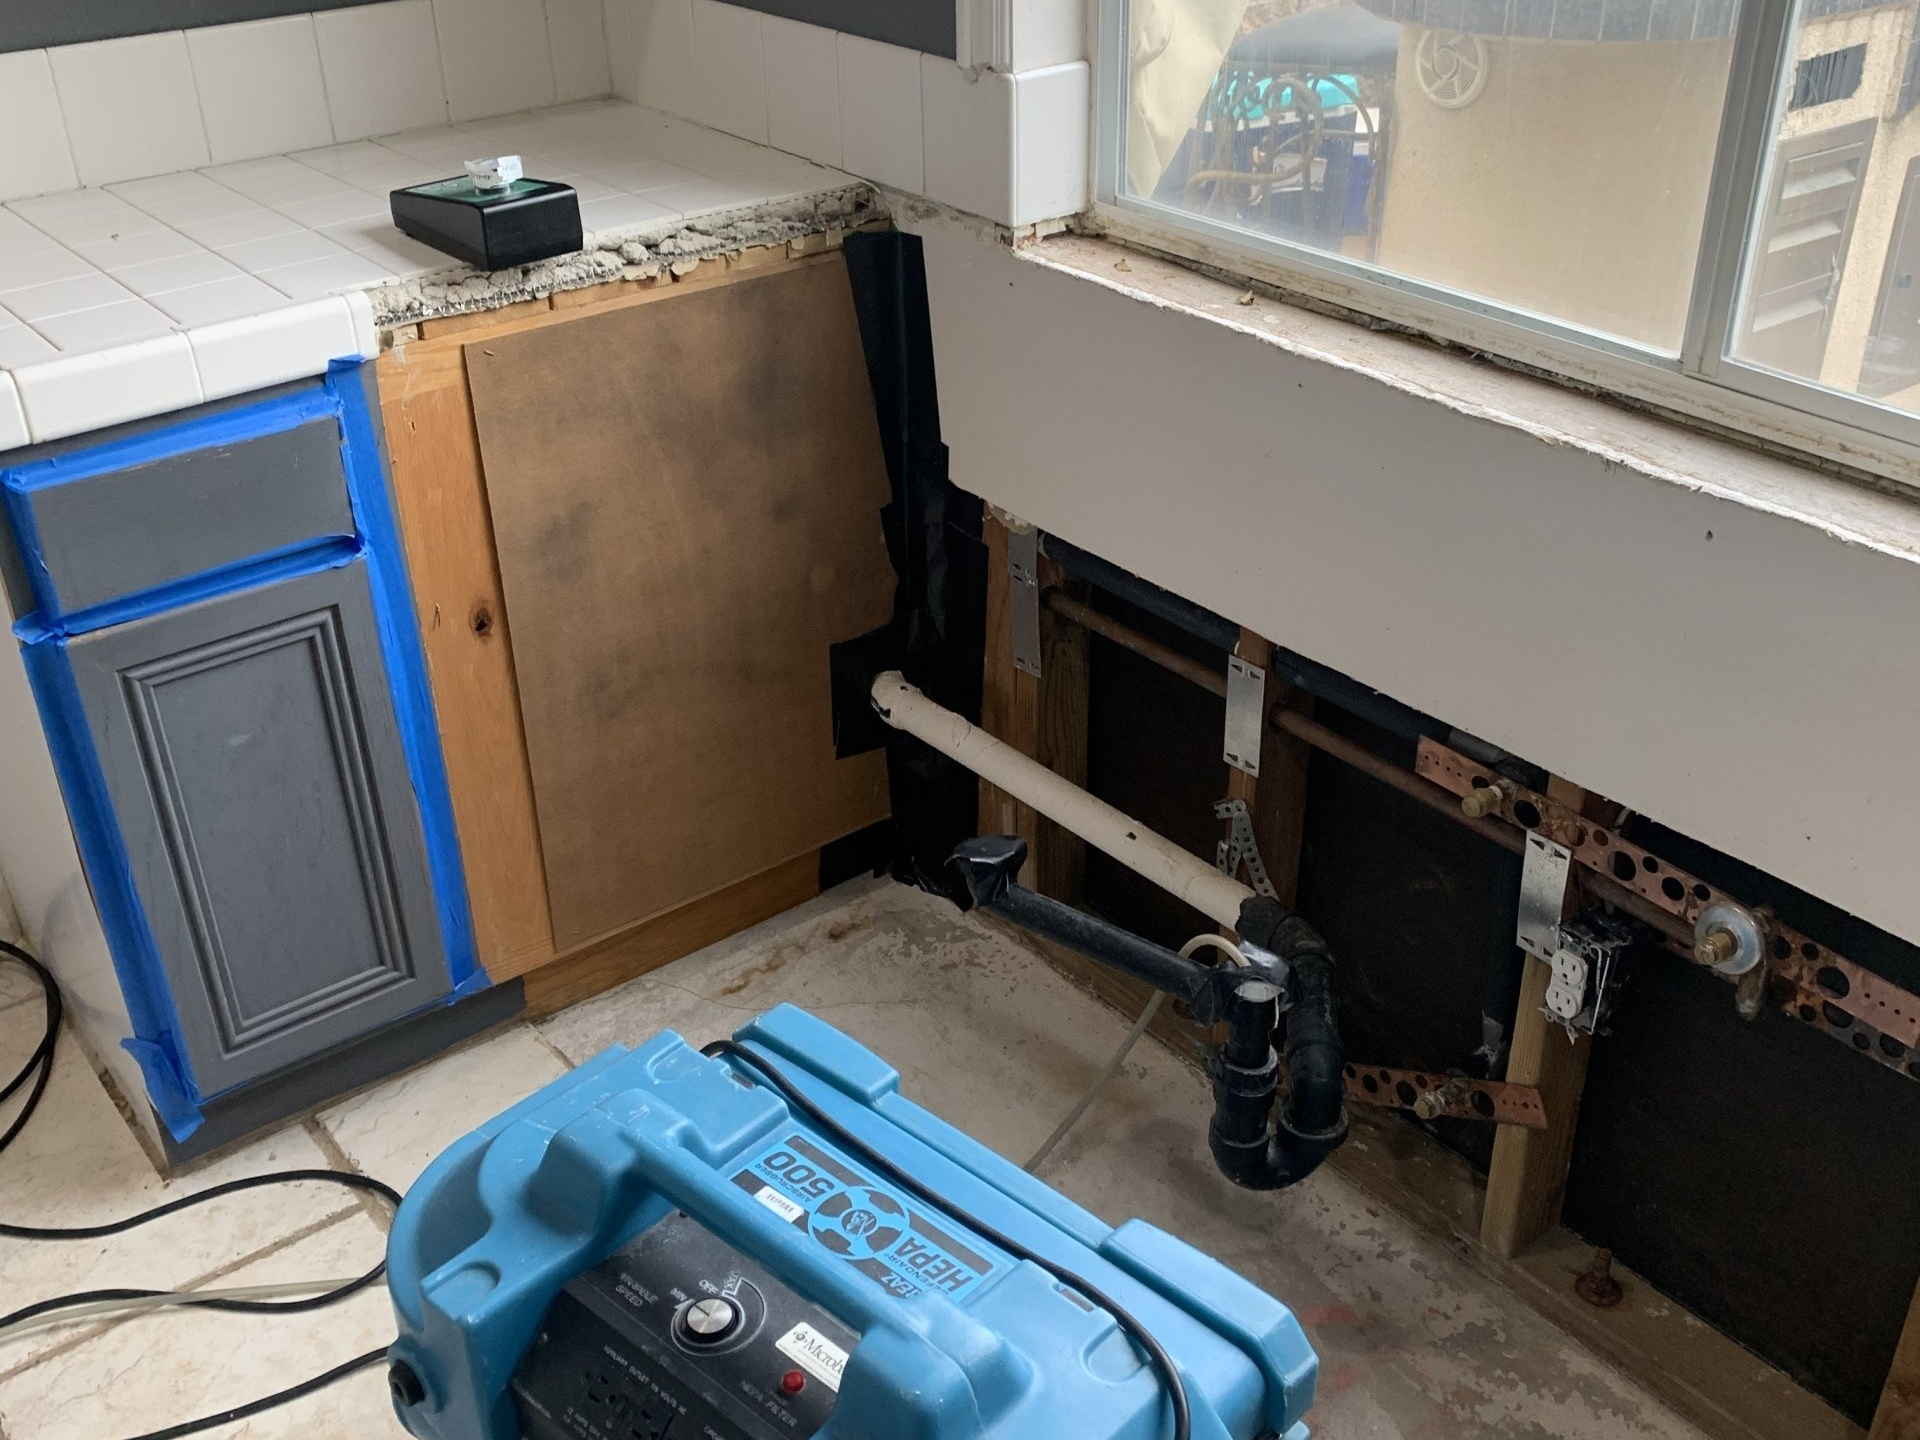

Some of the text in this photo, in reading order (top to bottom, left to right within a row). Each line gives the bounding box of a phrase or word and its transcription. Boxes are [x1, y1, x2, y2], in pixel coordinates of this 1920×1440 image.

[755, 1163, 812, 1202] AIRSCRUBBER
[763, 1151, 835, 1199] 500
[895, 1237, 974, 1292] HEPA
[615, 1284, 643, 1307] SPEED
[698, 1279, 719, 1295] OFF
[628, 1366, 650, 1384] OUTLET
[660, 1390, 677, 1408] VOLTS
[678, 1405, 687, 1415] AC
[764, 1400, 798, 1428] FILTER
